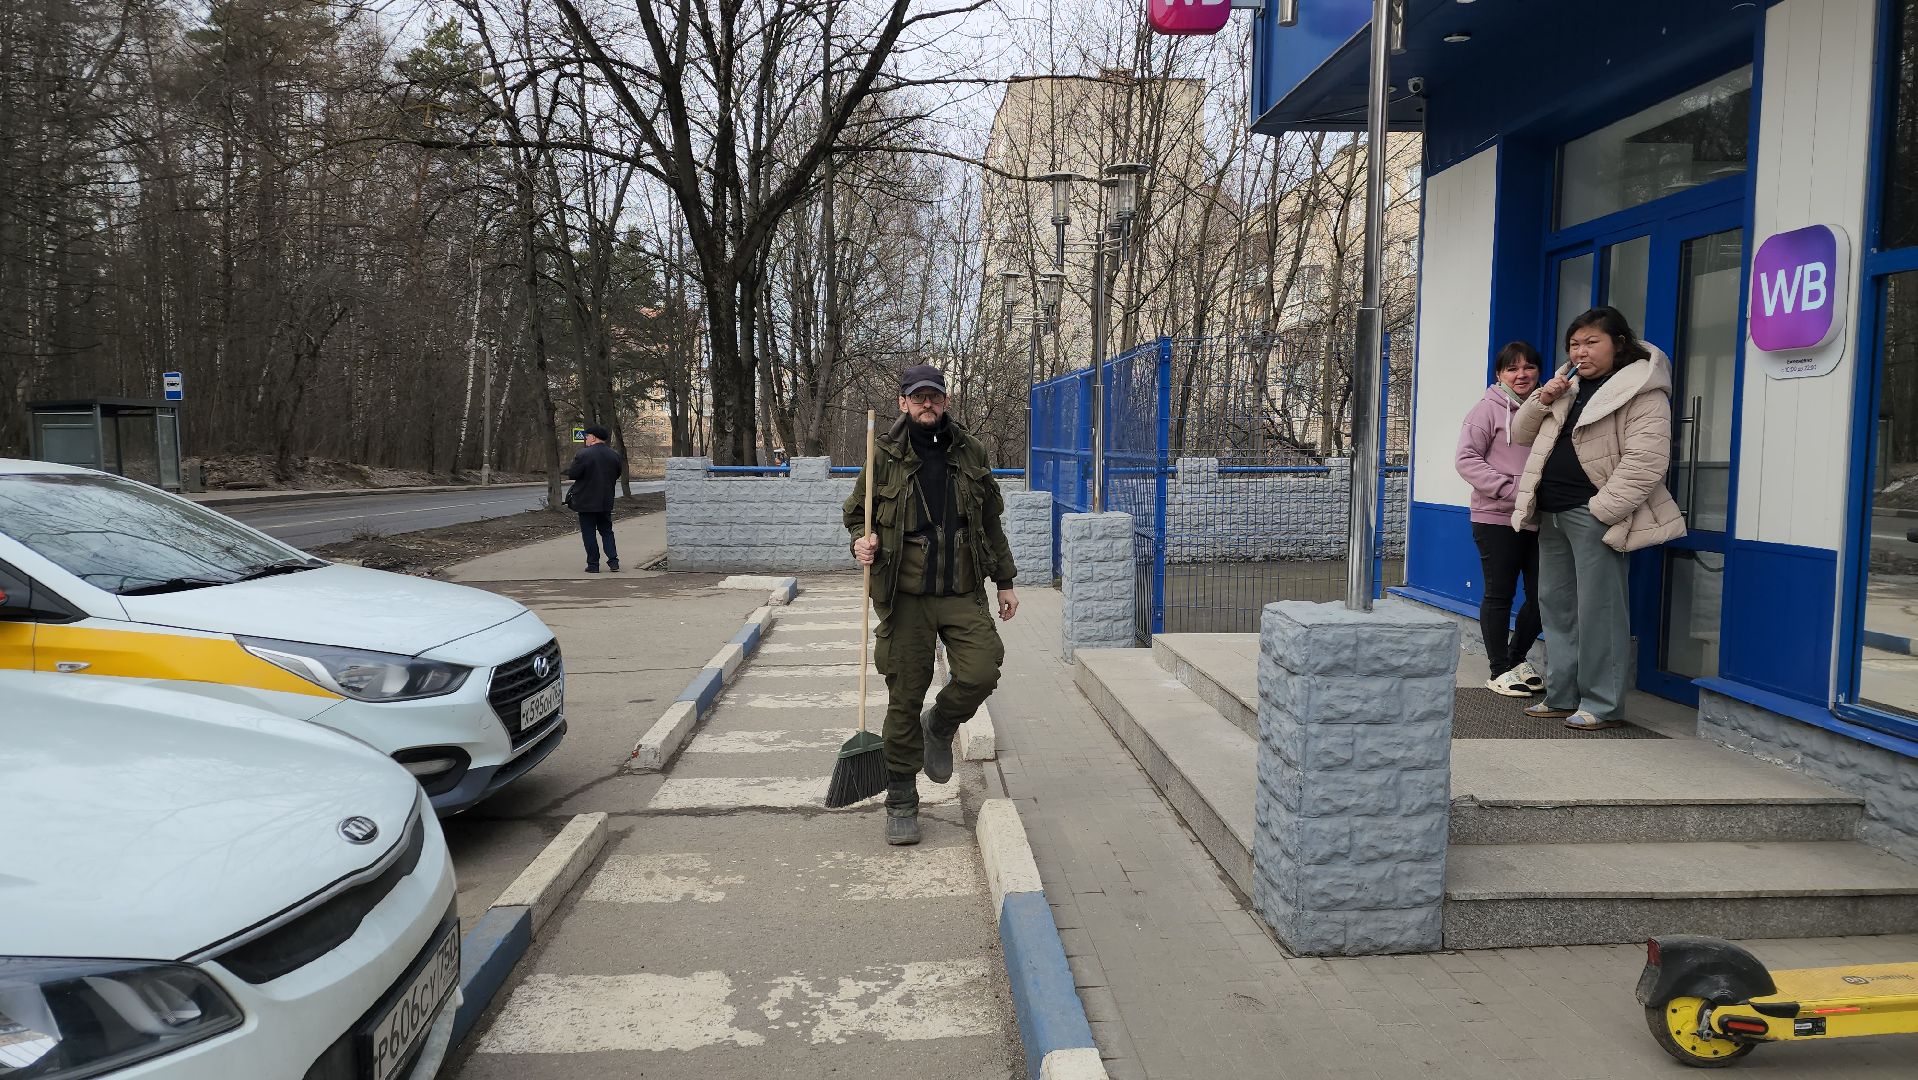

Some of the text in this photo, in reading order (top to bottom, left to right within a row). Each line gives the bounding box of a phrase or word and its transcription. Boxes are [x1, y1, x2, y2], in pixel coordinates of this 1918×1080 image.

[1760, 261, 1827, 317] WB
[378, 969, 437, 1079] Р606СУ
[439, 931, 457, 980] 750
